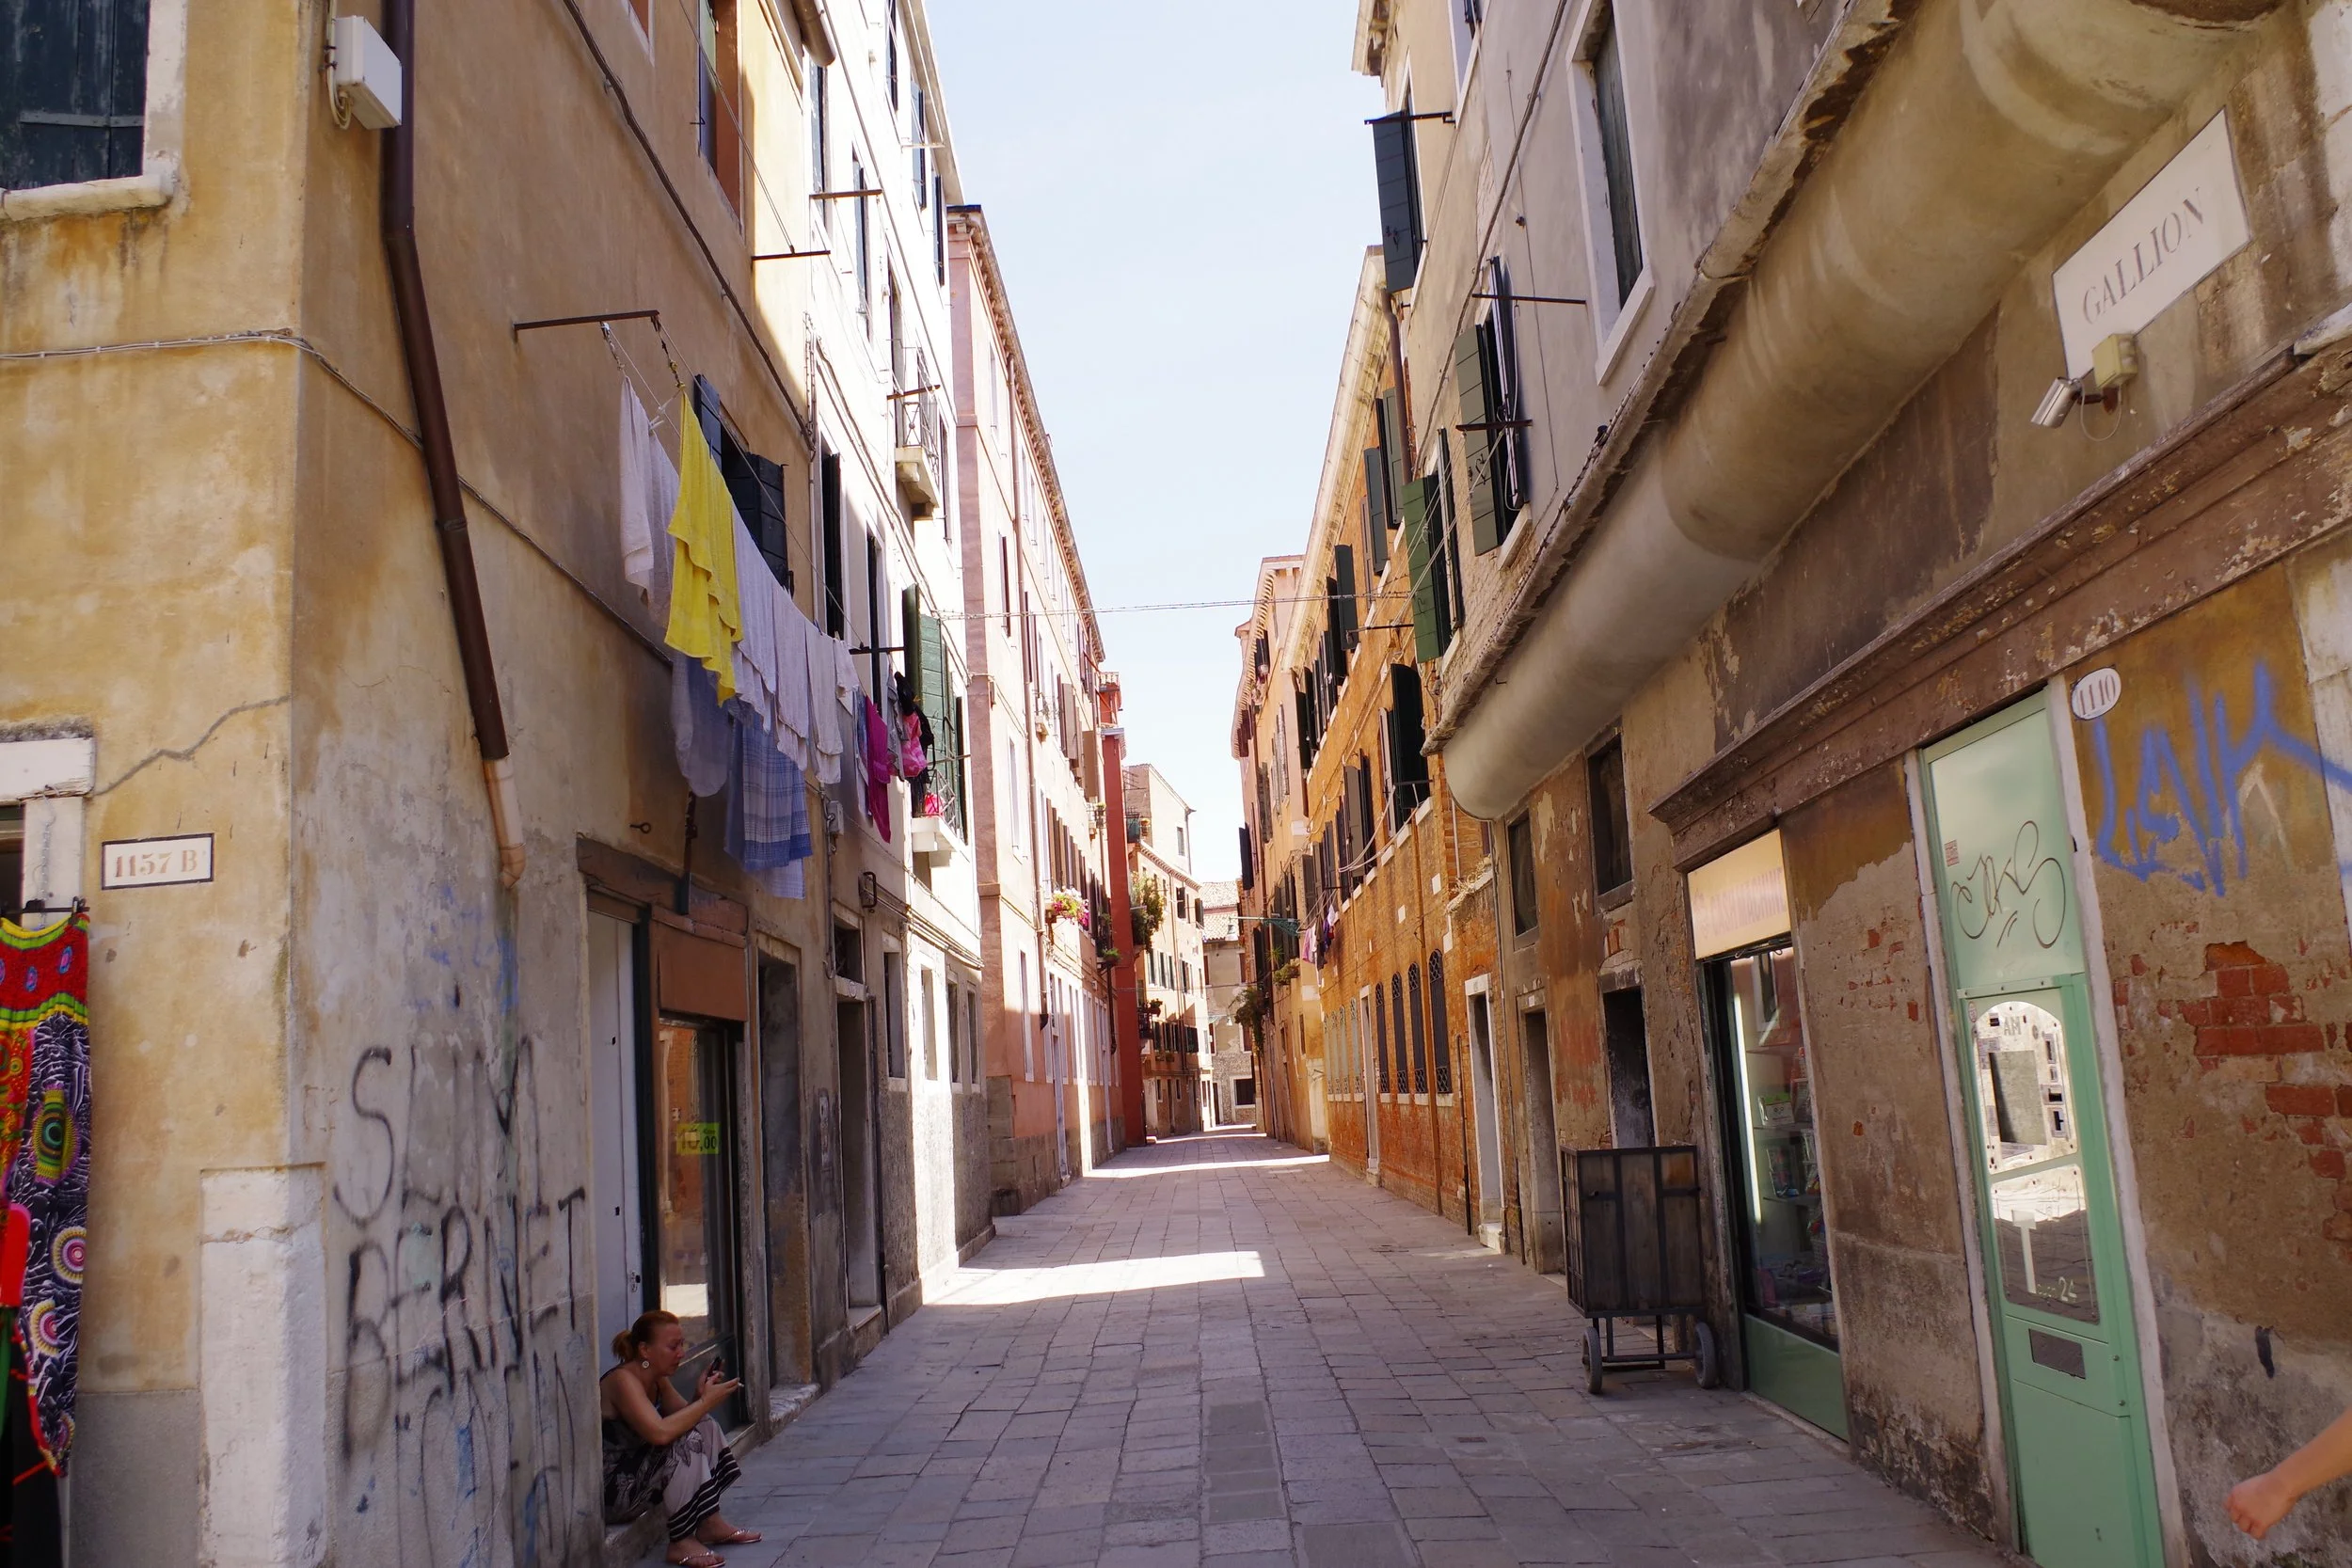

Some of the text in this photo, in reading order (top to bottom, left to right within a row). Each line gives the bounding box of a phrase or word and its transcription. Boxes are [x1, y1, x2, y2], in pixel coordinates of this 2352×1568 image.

[2083, 186, 2203, 325] GALLION
[2079, 673, 2116, 716] 1110
[115, 849, 198, 878] 1157 B
